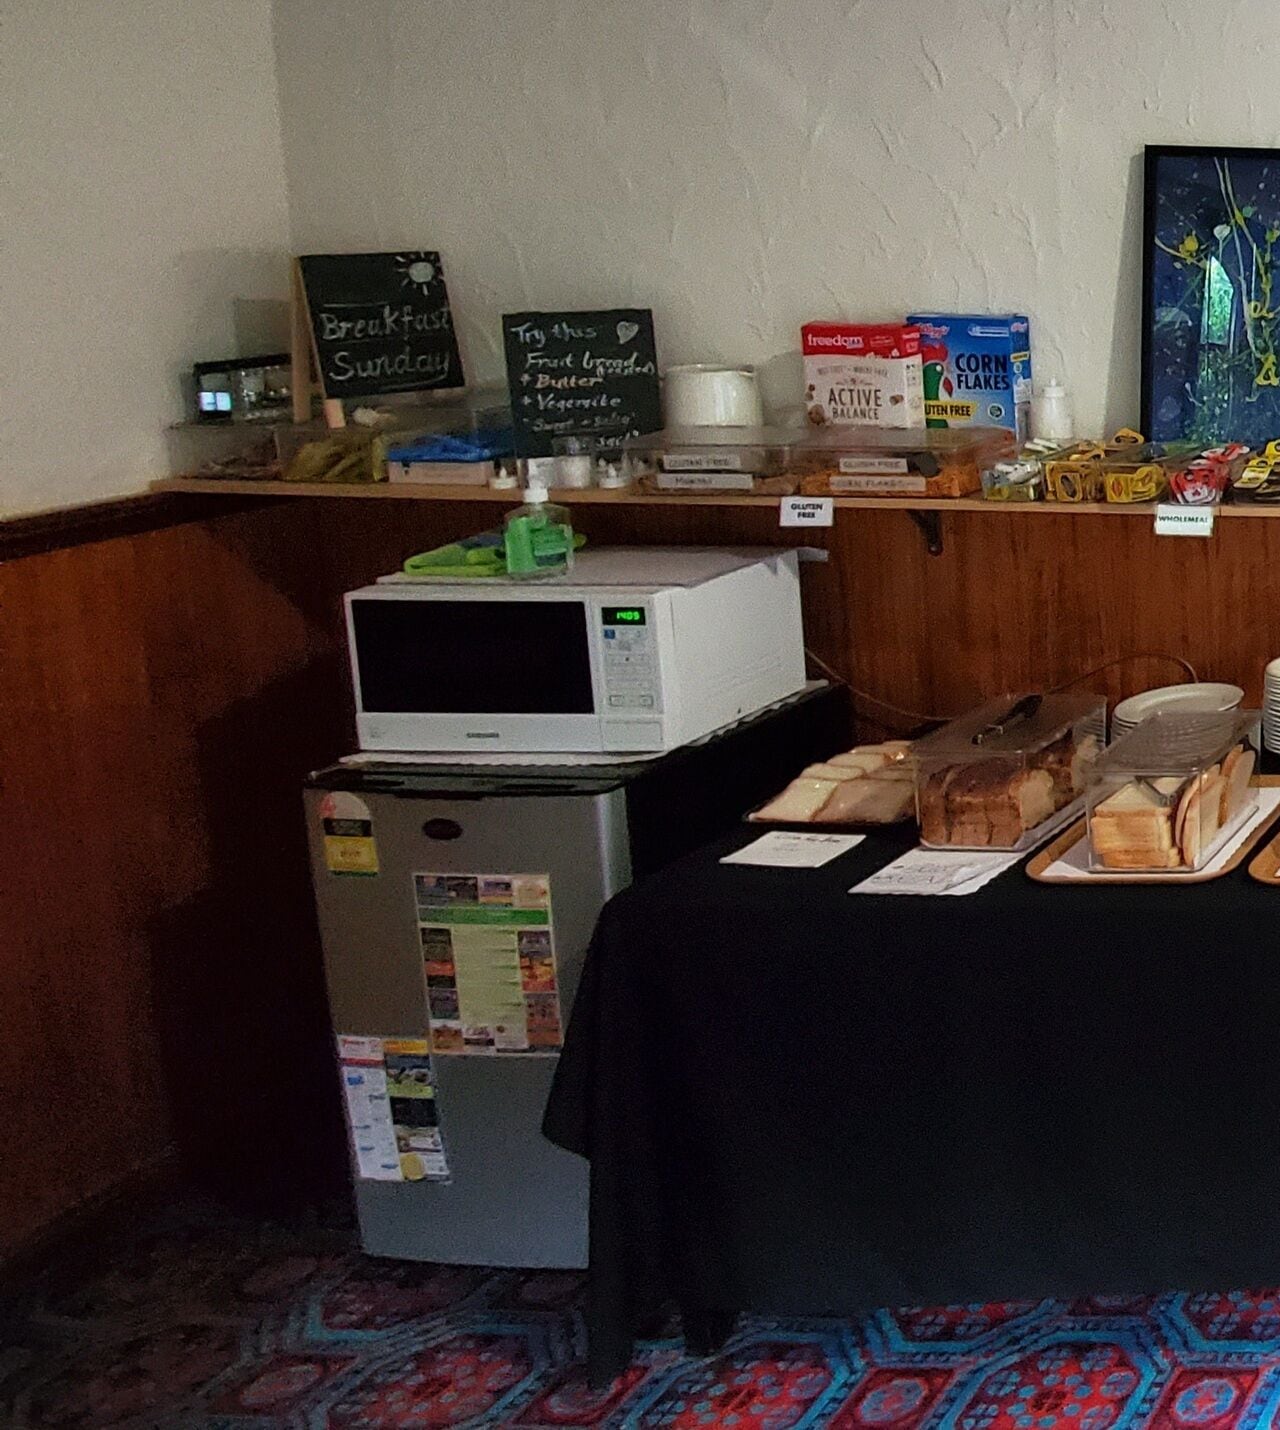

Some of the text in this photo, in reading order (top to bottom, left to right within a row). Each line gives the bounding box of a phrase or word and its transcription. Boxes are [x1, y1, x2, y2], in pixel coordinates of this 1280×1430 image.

[320, 305, 450, 341] Breakfast
[511, 321, 597, 348] Try this
[328, 345, 450, 382] Sunday
[525, 352, 574, 368] Fruit
[955, 353, 1008, 373] CORN
[535, 373, 603, 389] Butter
[956, 374, 1010, 390] FLAKES
[537, 393, 621, 412] Vegemite
[828, 388, 883, 407] ACTIVE
[832, 407, 880, 420] BALANCE
[925, 404, 970, 416] UTEN FREE
[791, 503, 822, 511] GLUTEN
[1159, 515, 1208, 523] WHOLEMEAL
